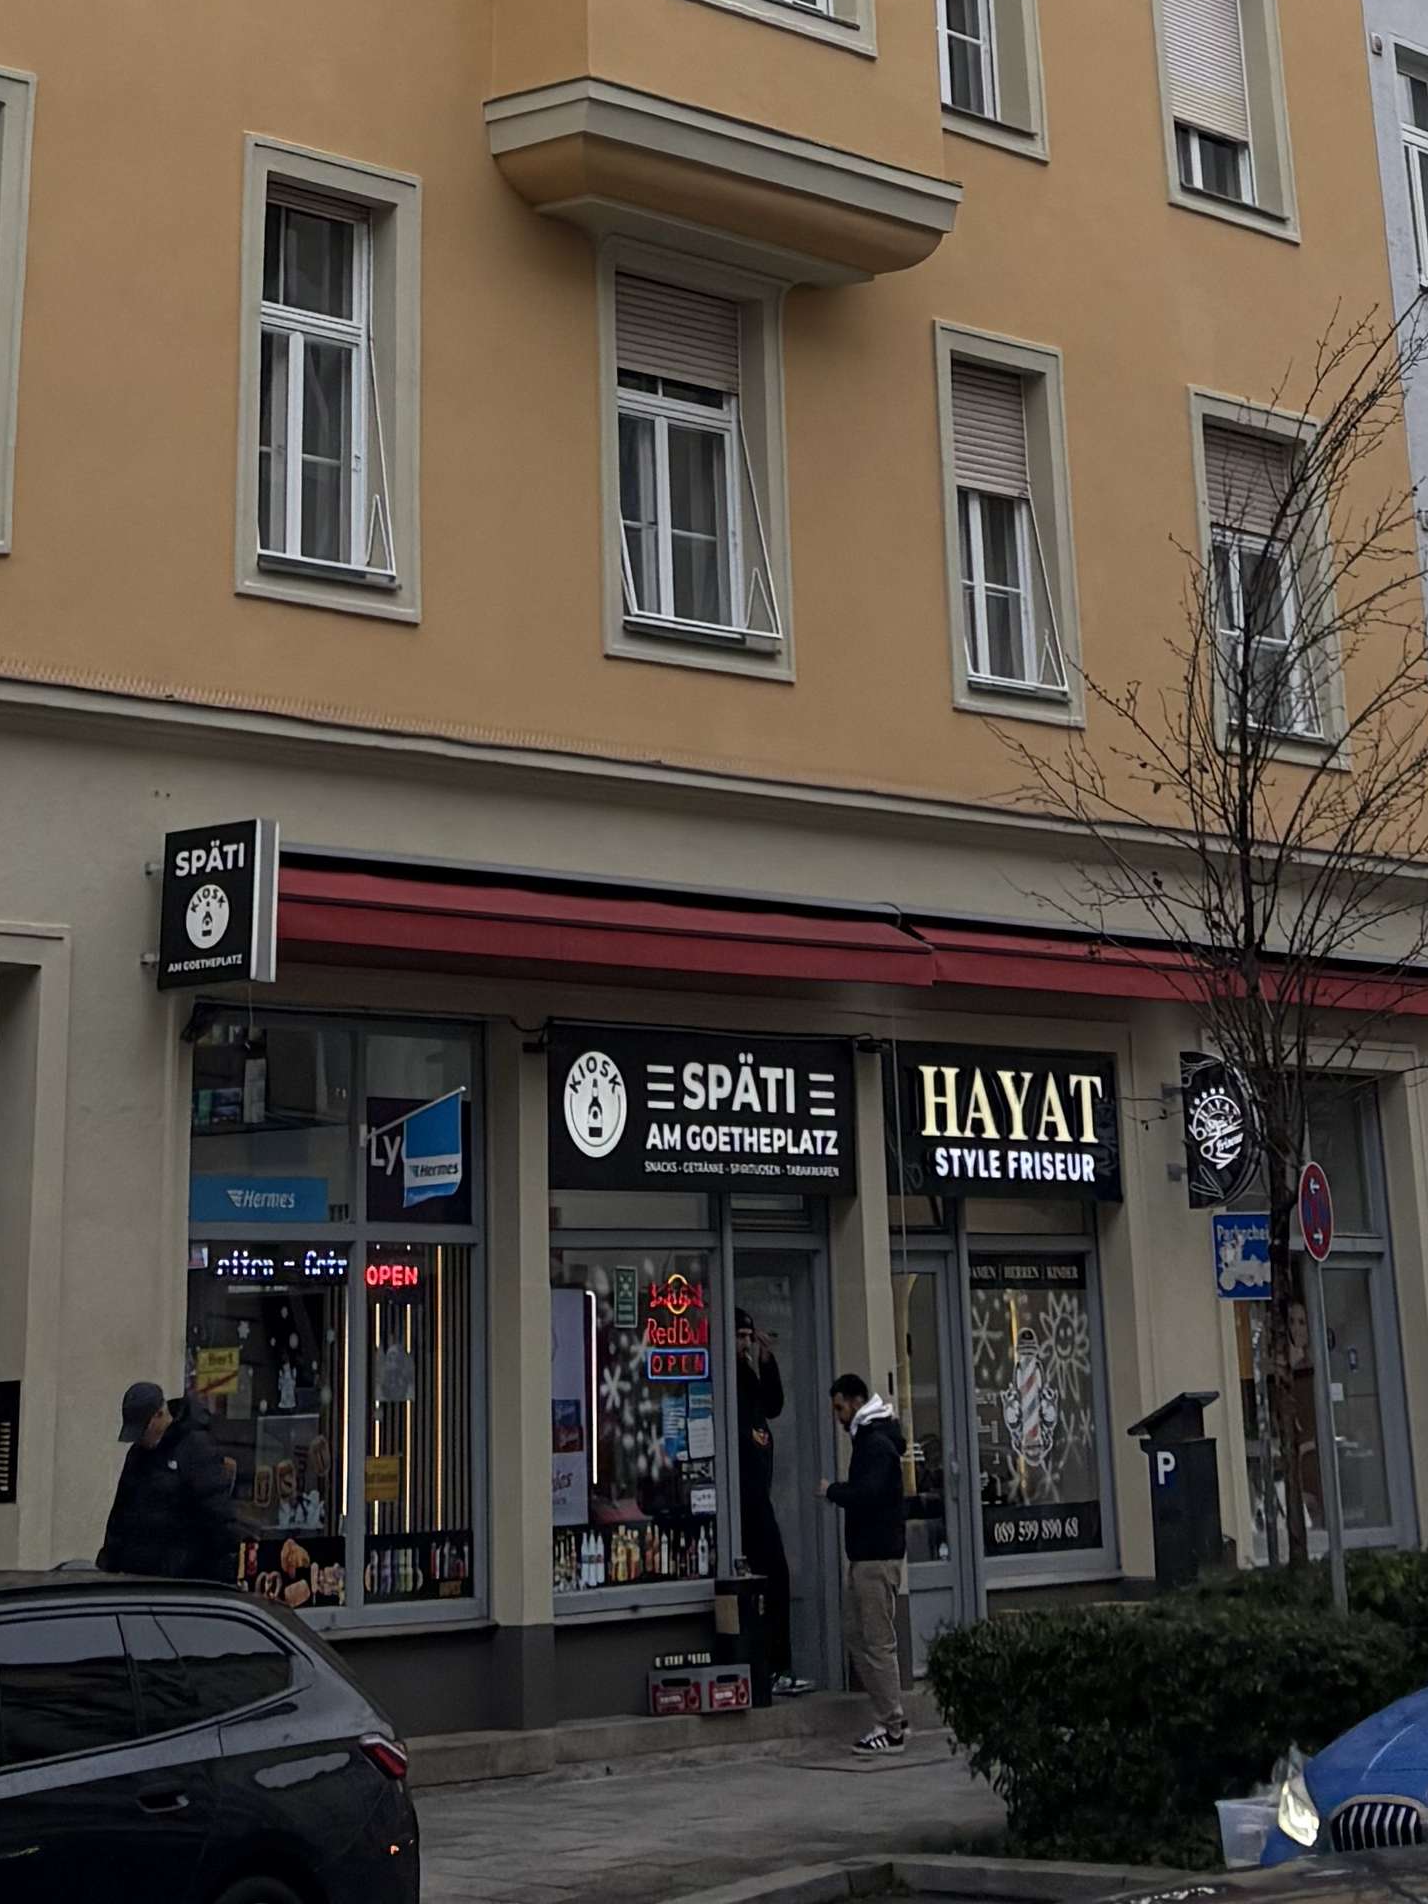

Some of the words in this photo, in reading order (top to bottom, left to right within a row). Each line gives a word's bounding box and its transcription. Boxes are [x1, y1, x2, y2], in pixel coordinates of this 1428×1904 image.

[175, 839, 245, 877] SPÄTI
[190, 887, 227, 913] KIOSK
[167, 961, 182, 973] AM
[183, 954, 243, 972] GOETHEPLATZ
[568, 1055, 622, 1095] KIOSK
[682, 1052, 796, 1114] SPÄTI
[918, 1065, 1104, 1143] HAYAT
[645, 1123, 681, 1151] AM
[686, 1124, 840, 1156] GOETHEPLATZ
[644, 1160, 678, 1174] SNACKS
[935, 1146, 1002, 1178] STYLE
[1007, 1149, 1096, 1183] FRISEUR
[243, 1189, 295, 1209] Hermes
[365, 1264, 419, 1286] OPEN
[652, 1354, 704, 1374] OPEN
[1156, 1451, 1177, 1485] P
[994, 1522, 1016, 1544] 089
[1018, 1520, 1039, 1542] 599
[1041, 1518, 1062, 1539] 890
[1065, 1516, 1079, 1538] 68
